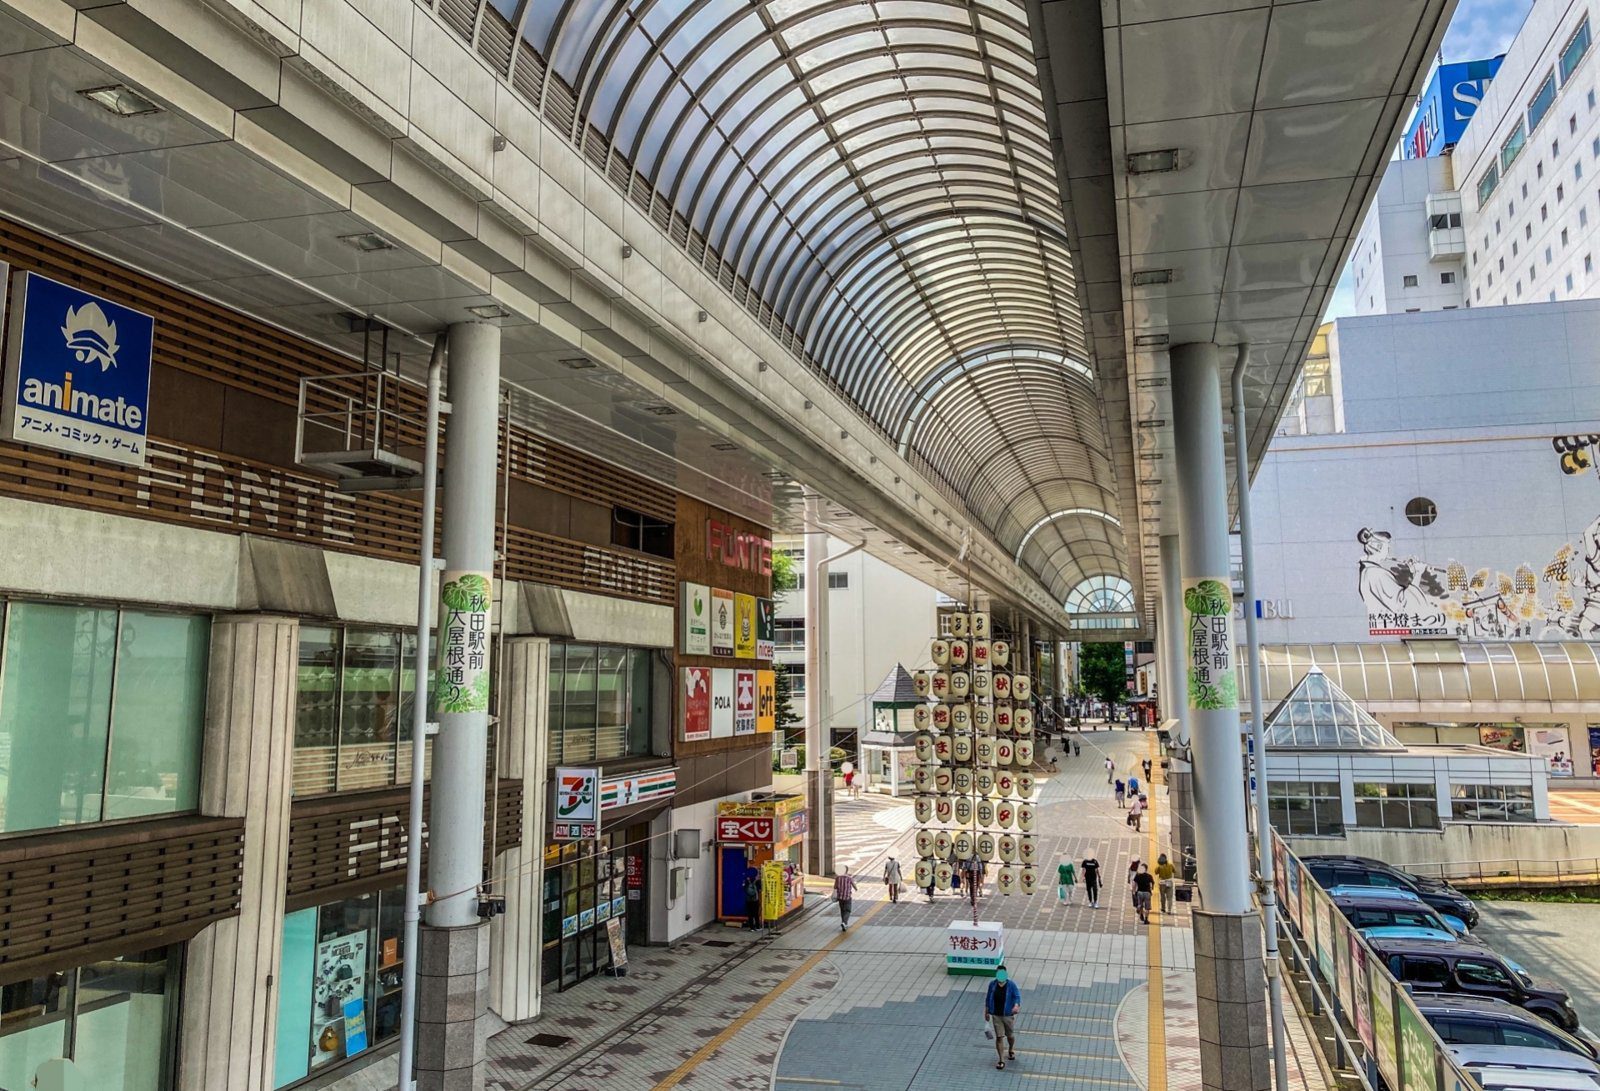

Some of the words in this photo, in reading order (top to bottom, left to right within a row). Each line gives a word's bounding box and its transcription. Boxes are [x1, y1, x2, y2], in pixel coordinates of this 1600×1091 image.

[23, 371, 142, 429] animate
[21, 416, 139, 454] アニメ・コミック・ゲーム
[445, 607, 466, 705] 大屋根通り
[468, 594, 486, 670] 秋田駅前
[1209, 598, 1229, 670] 秋田駅前
[1191, 613, 1211, 701] 大屋根通り
[714, 696, 731, 709] POLA
[555, 825, 568, 836] ATM
[721, 820, 770, 839] 宝くじ
[949, 935, 997, 951] 竿燈まつり
